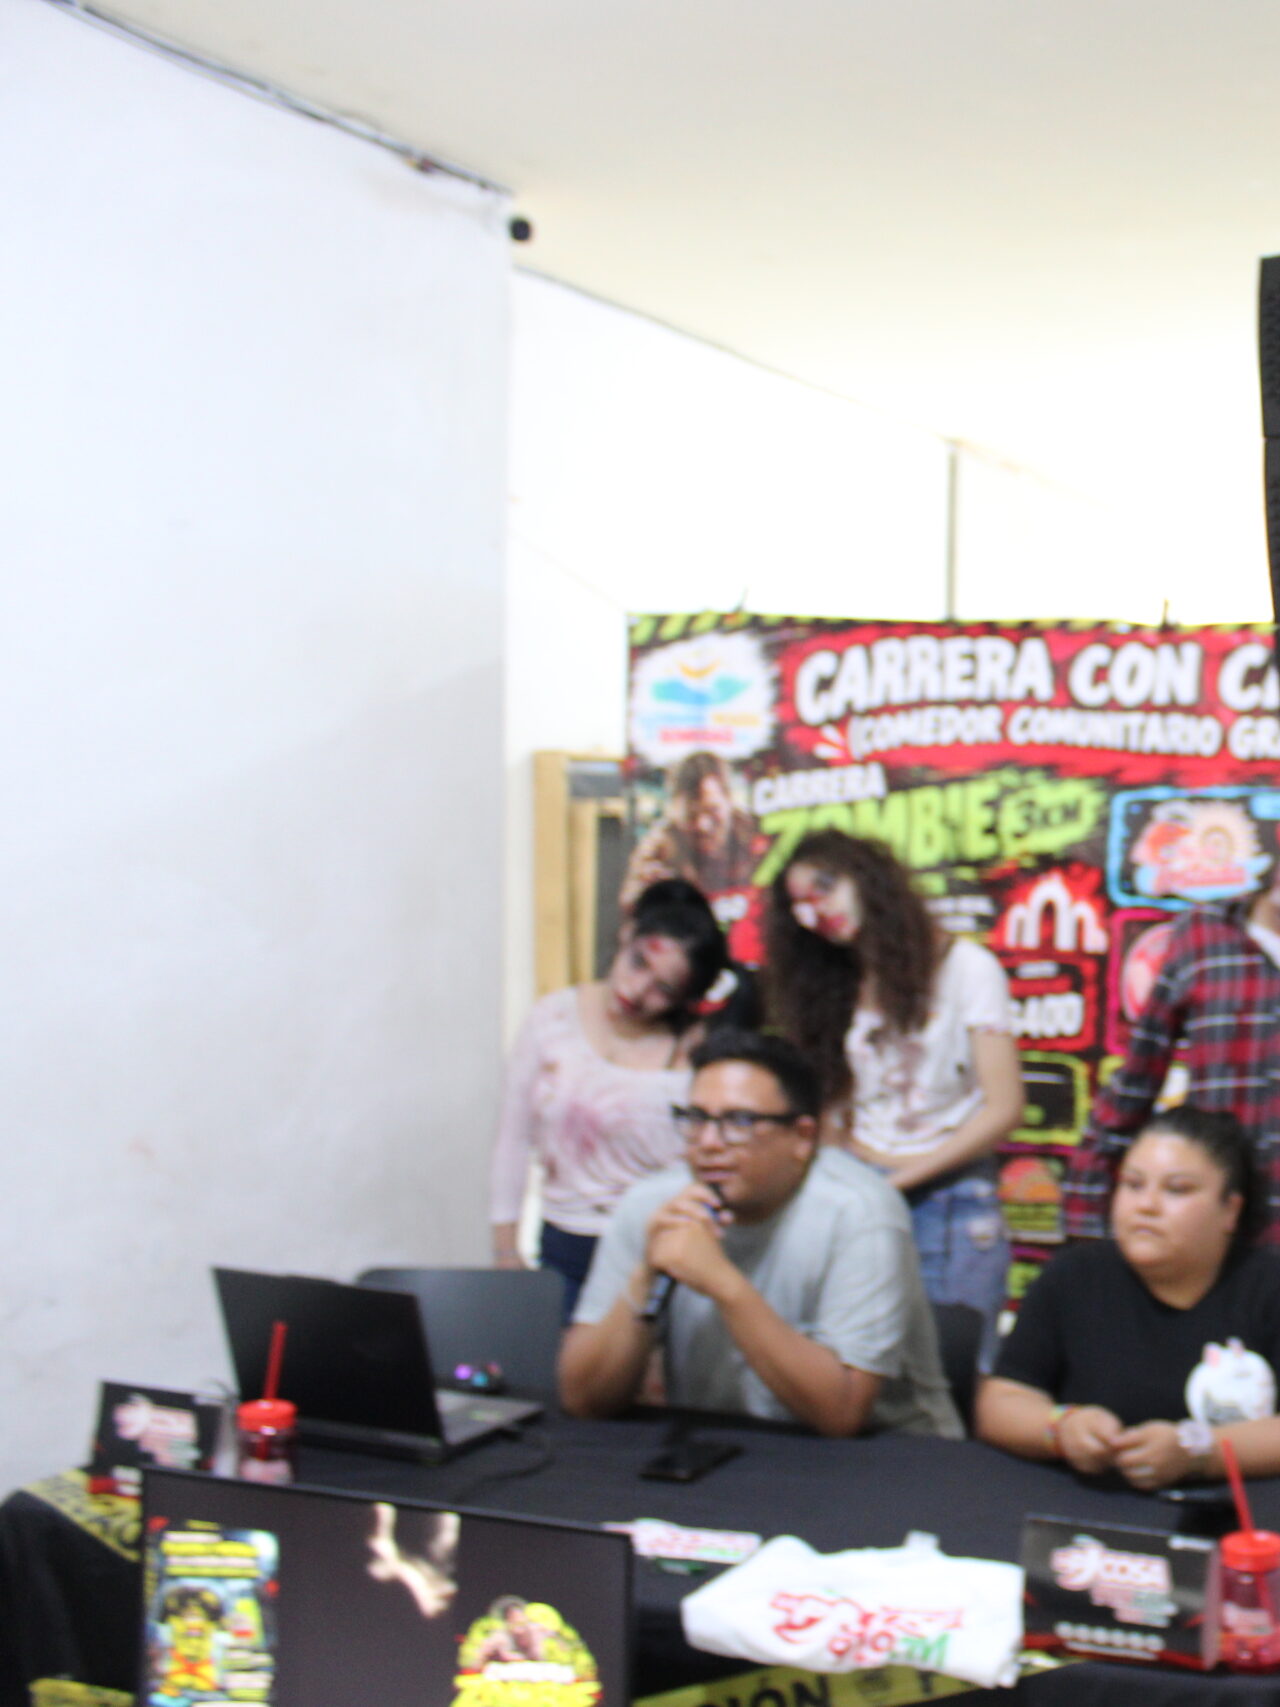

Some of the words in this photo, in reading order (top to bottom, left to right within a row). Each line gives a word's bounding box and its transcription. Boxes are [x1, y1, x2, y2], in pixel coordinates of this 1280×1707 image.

[795, 635, 1054, 725] CARRERA
[1068, 640, 1203, 708] CON
[1007, 704, 1222, 758] COMUNITARIO
